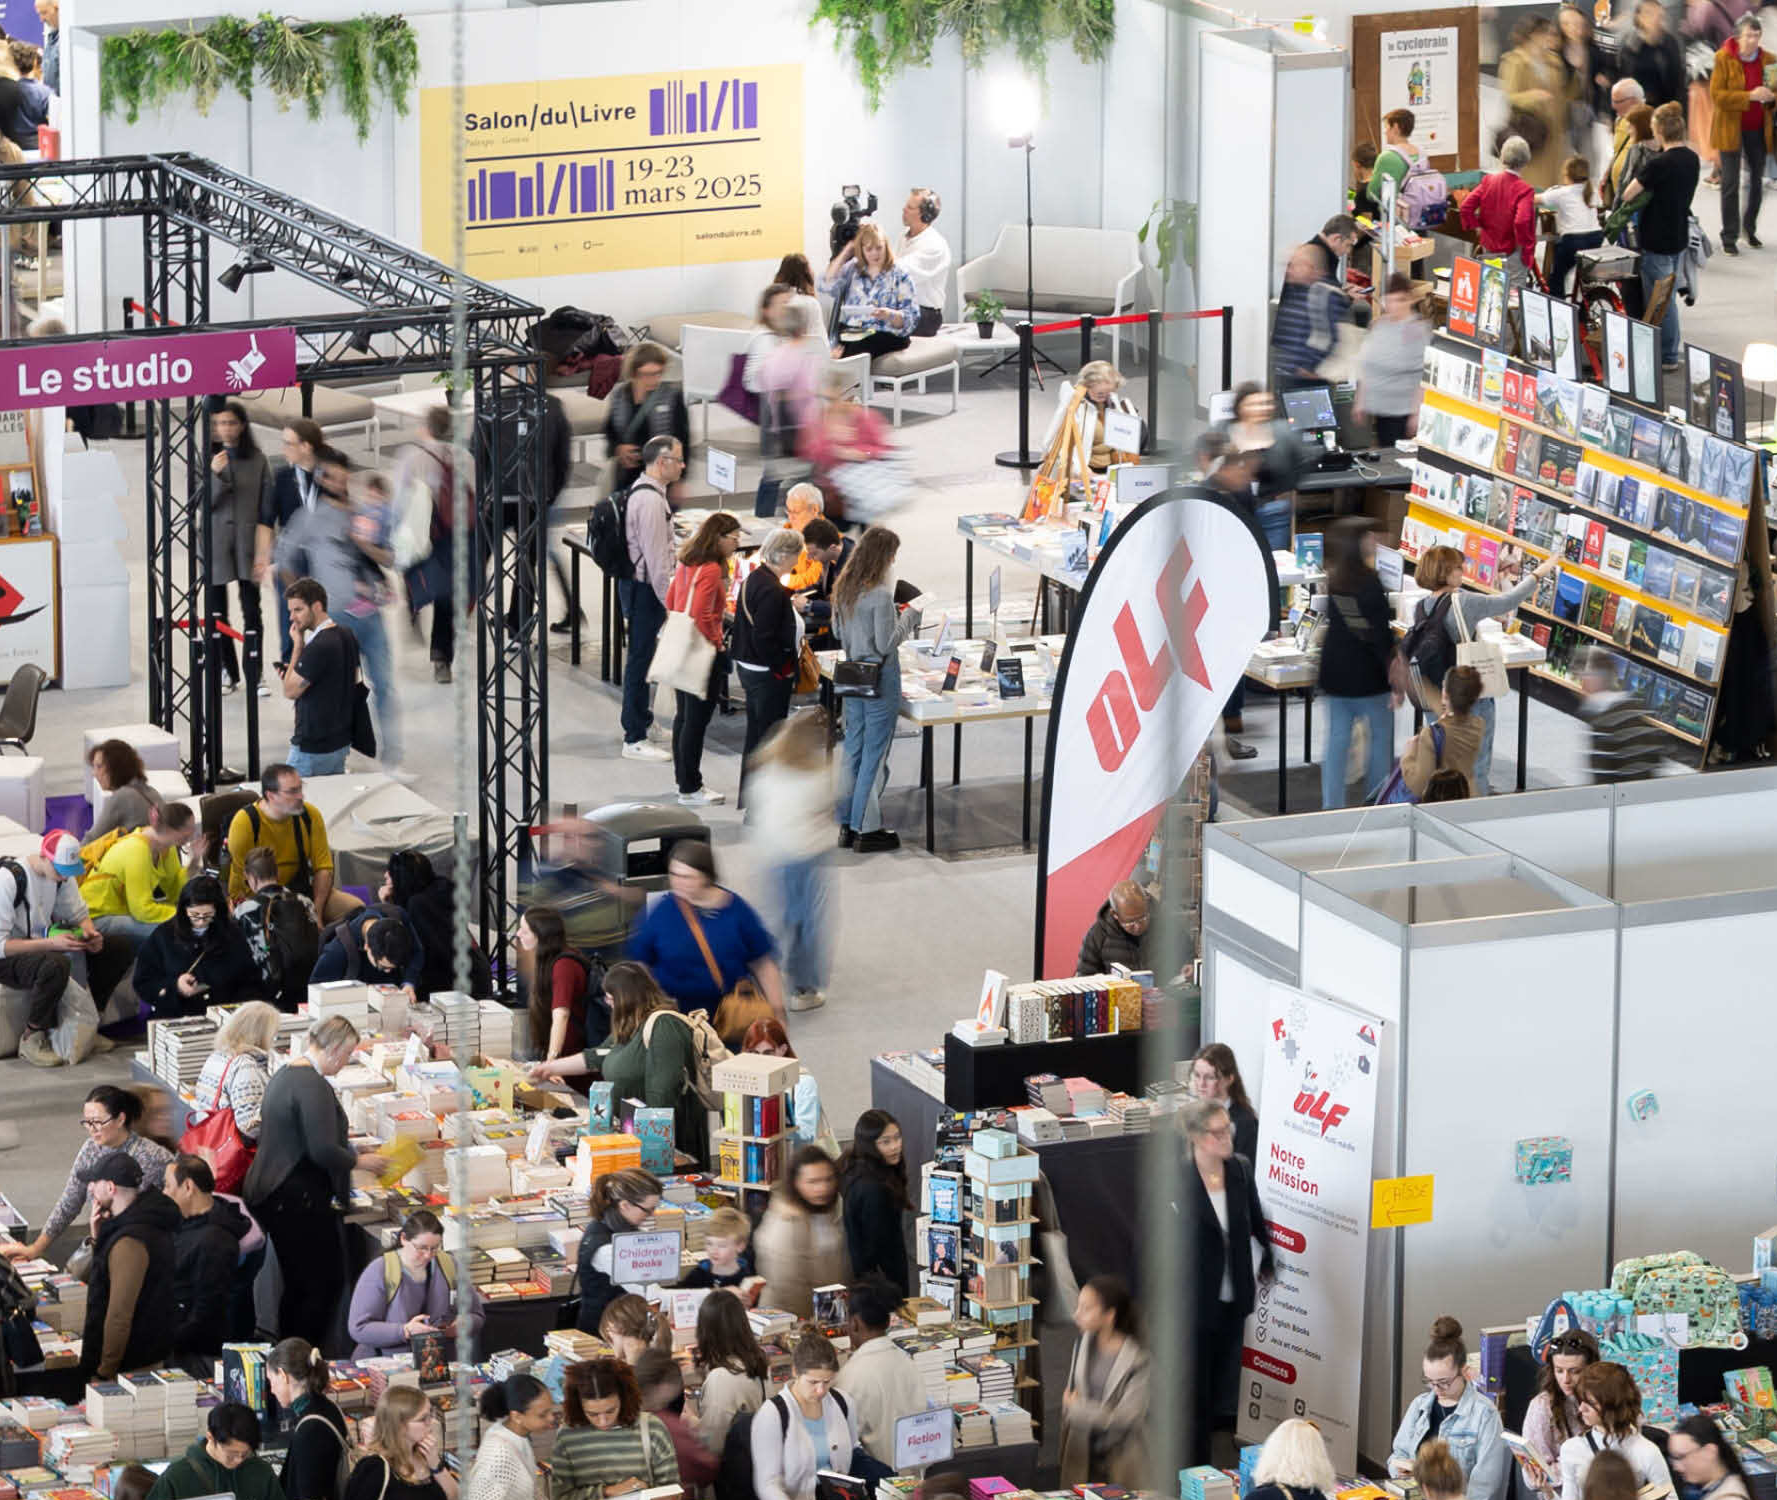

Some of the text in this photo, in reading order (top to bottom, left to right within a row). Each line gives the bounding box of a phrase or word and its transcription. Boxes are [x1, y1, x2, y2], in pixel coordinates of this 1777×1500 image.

[624, 155, 694, 181] 19-23
[625, 174, 762, 205] mars 2025
[18, 352, 192, 396] Le studio
[1085, 532, 1215, 773] OLF
[1293, 1091, 1350, 1138] OLF
[1271, 1143, 1305, 1171] Notre
[1268, 1164, 1319, 1197] Mission
[1380, 1183, 1430, 1205] CAISSE
[618, 1245, 677, 1260] Children's
[631, 1259, 663, 1270] Books
[1253, 1355, 1289, 1380] Contacts
[907, 1431, 942, 1447] Fiction
